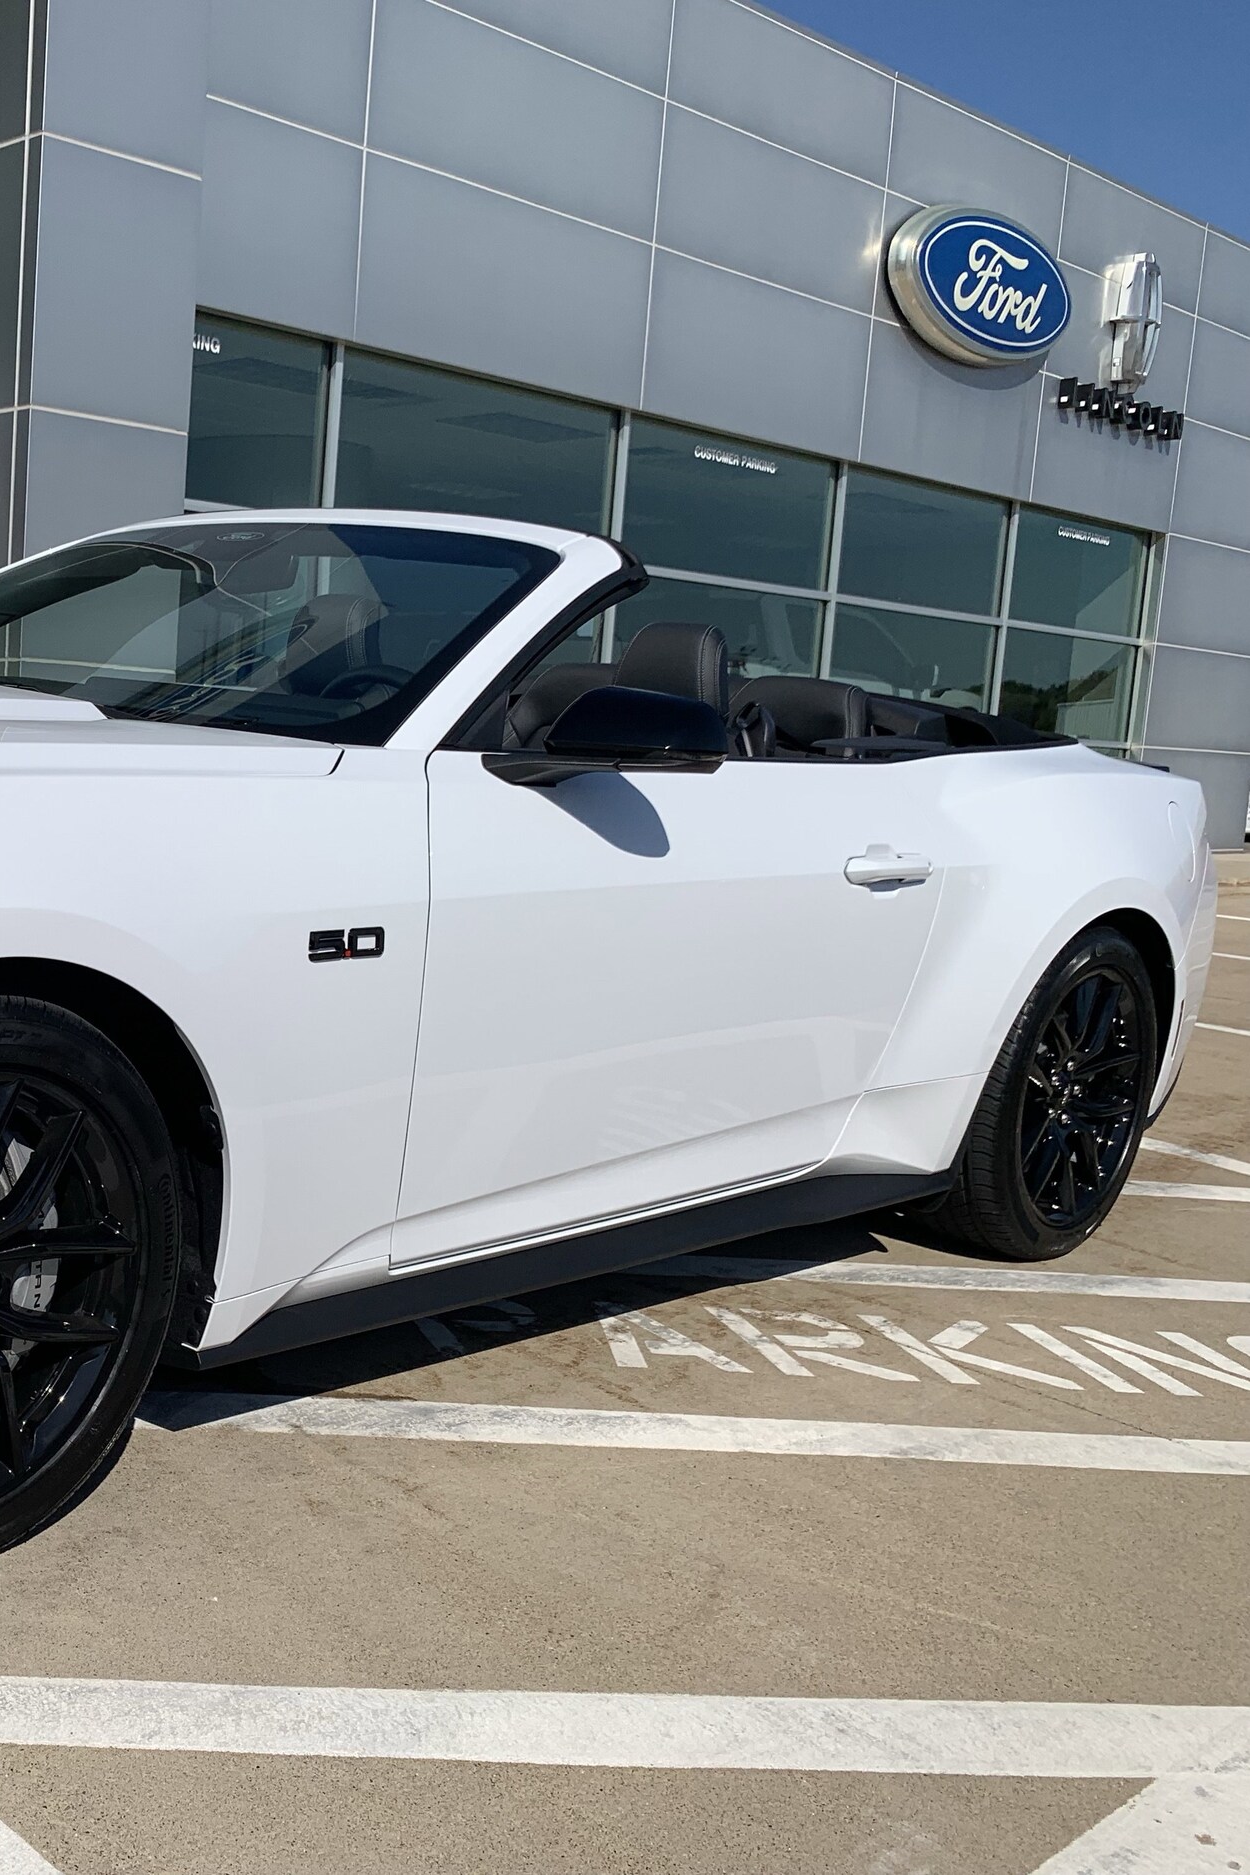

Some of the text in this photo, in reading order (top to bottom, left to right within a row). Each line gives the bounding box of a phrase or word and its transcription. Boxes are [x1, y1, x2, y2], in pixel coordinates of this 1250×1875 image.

[953, 238, 1048, 335] Ford
[694, 445, 777, 474] CUSTOMER PARKING
[308, 926, 385, 963] 5.0
[414, 1298, 1250, 1397] PARKIN
